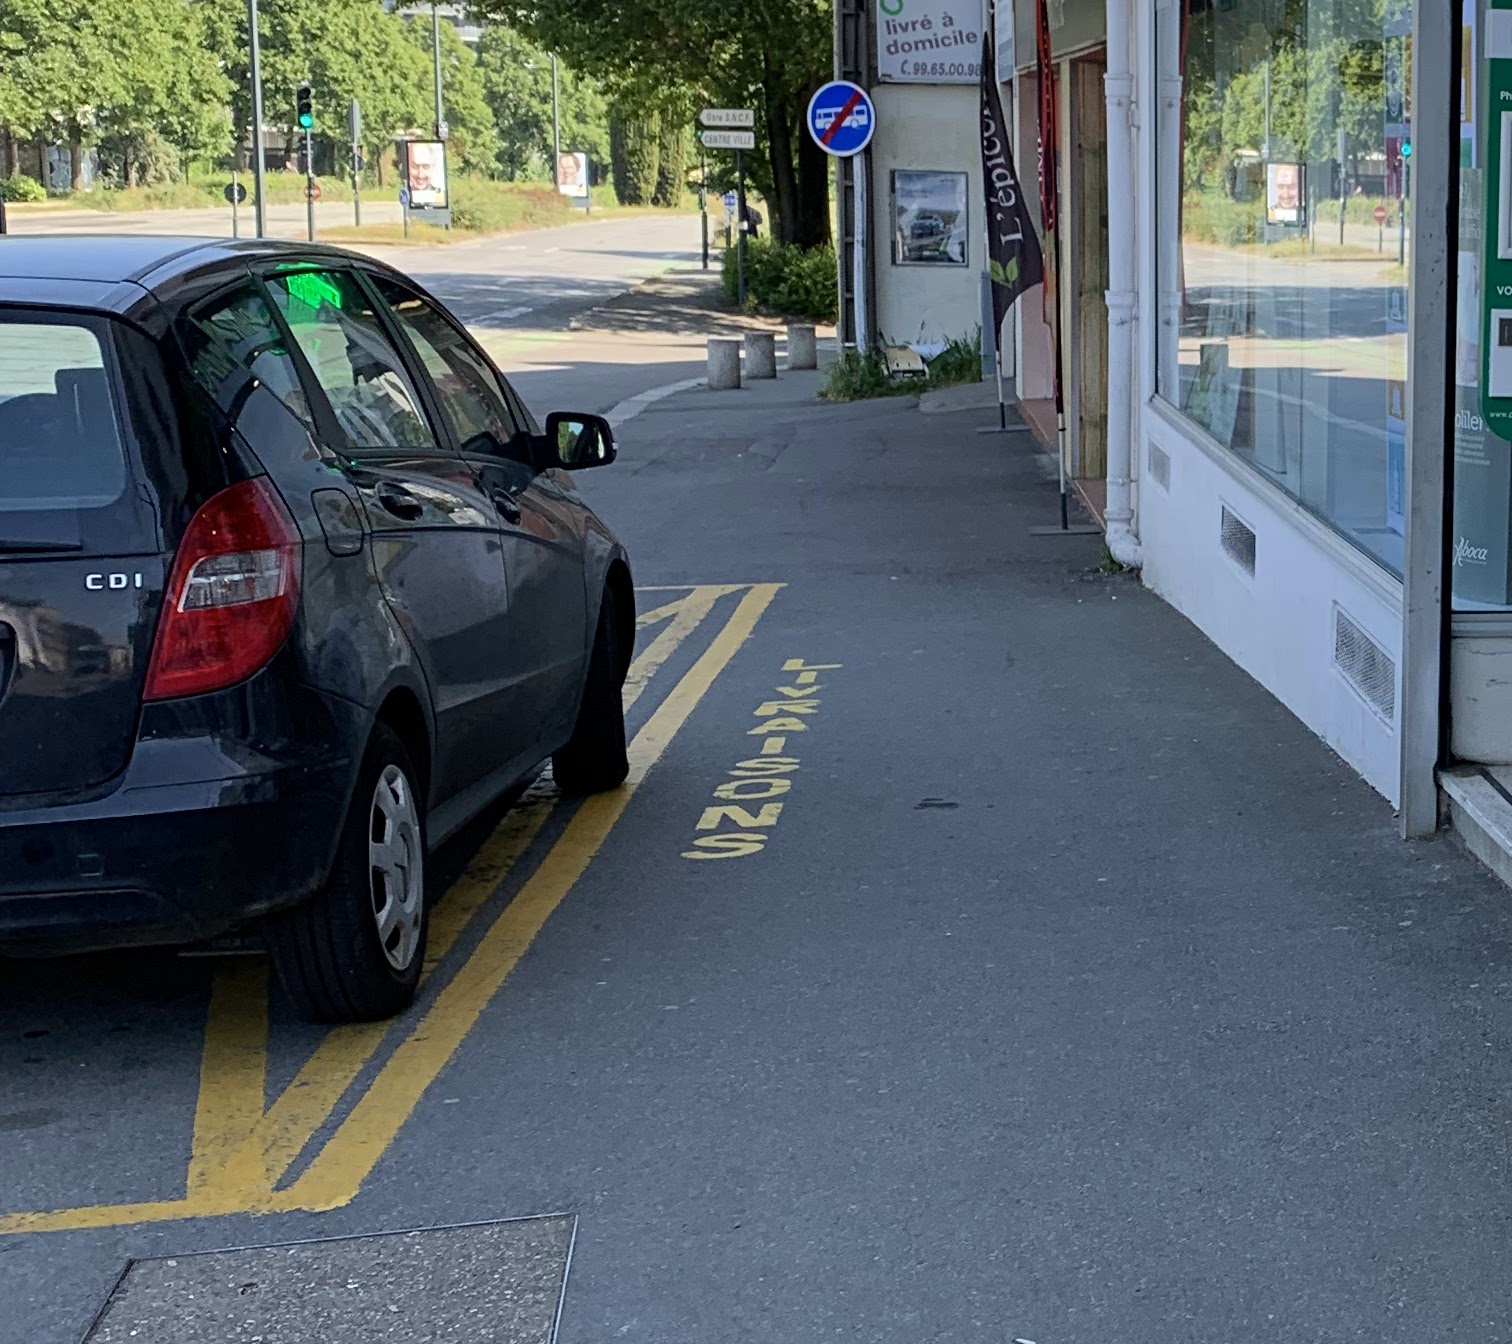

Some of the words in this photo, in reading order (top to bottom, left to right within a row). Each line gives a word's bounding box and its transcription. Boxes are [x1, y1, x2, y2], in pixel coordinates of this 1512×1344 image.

[885, 14, 933, 35] livré
[942, 11, 955, 28] à
[886, 29, 978, 56] domicile
[704, 135, 732, 145] CENTRE
[733, 136, 752, 146] VILLE
[85, 572, 143, 590] CDI
[680, 658, 844, 860] LIVRAISONS
